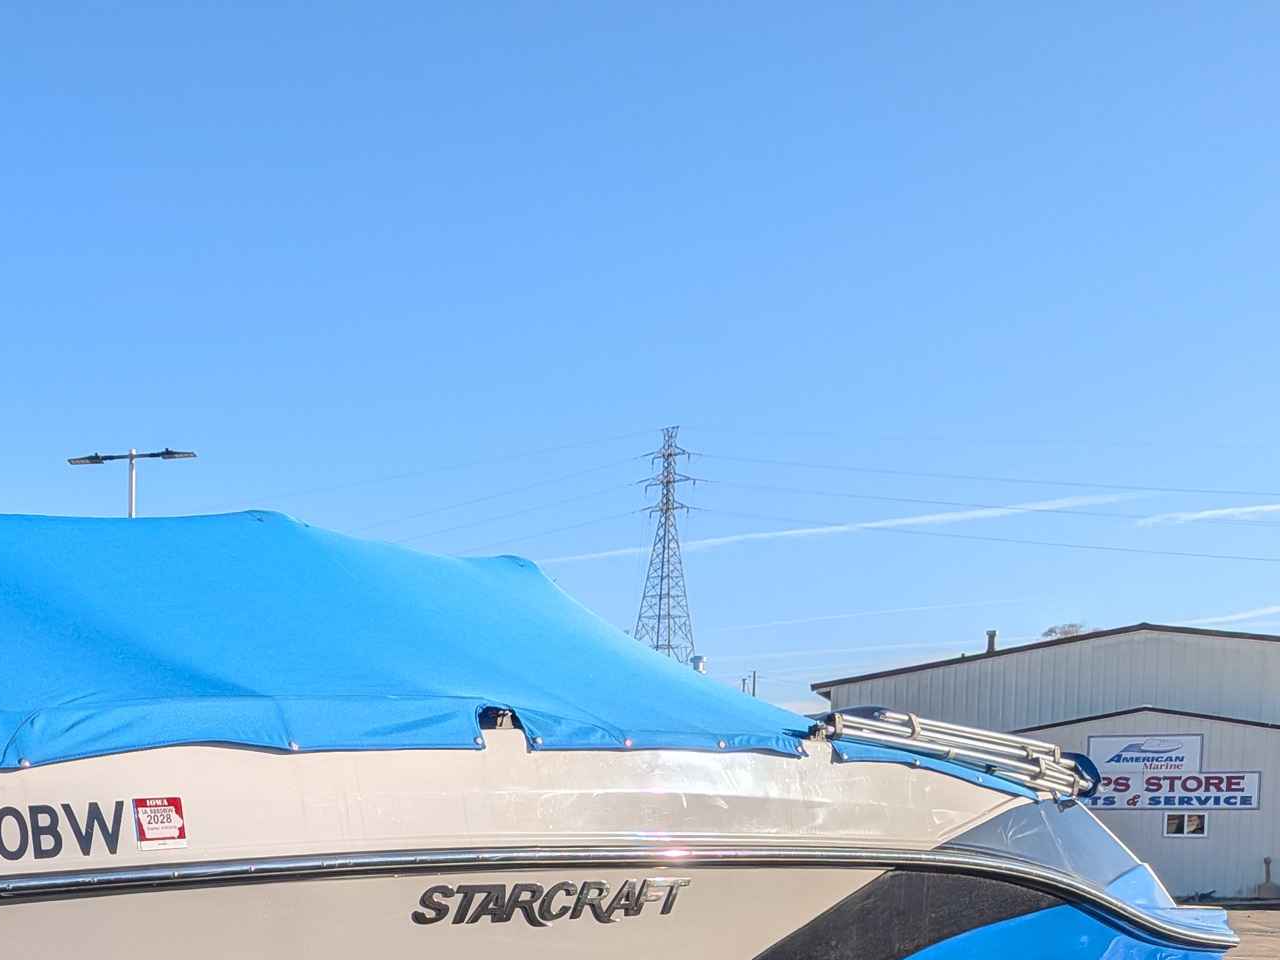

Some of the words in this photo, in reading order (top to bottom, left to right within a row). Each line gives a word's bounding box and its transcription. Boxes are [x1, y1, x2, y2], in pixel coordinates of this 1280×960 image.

[1105, 753, 1185, 763] AMERICAN
[1142, 762, 1183, 770] Marine
[1144, 776, 1245, 793] STORE
[1126, 794, 1141, 807] &
[1148, 795, 1253, 806] SERVICE
[146, 813, 172, 825] 2028
[411, 877, 691, 927] STARCRAFT
